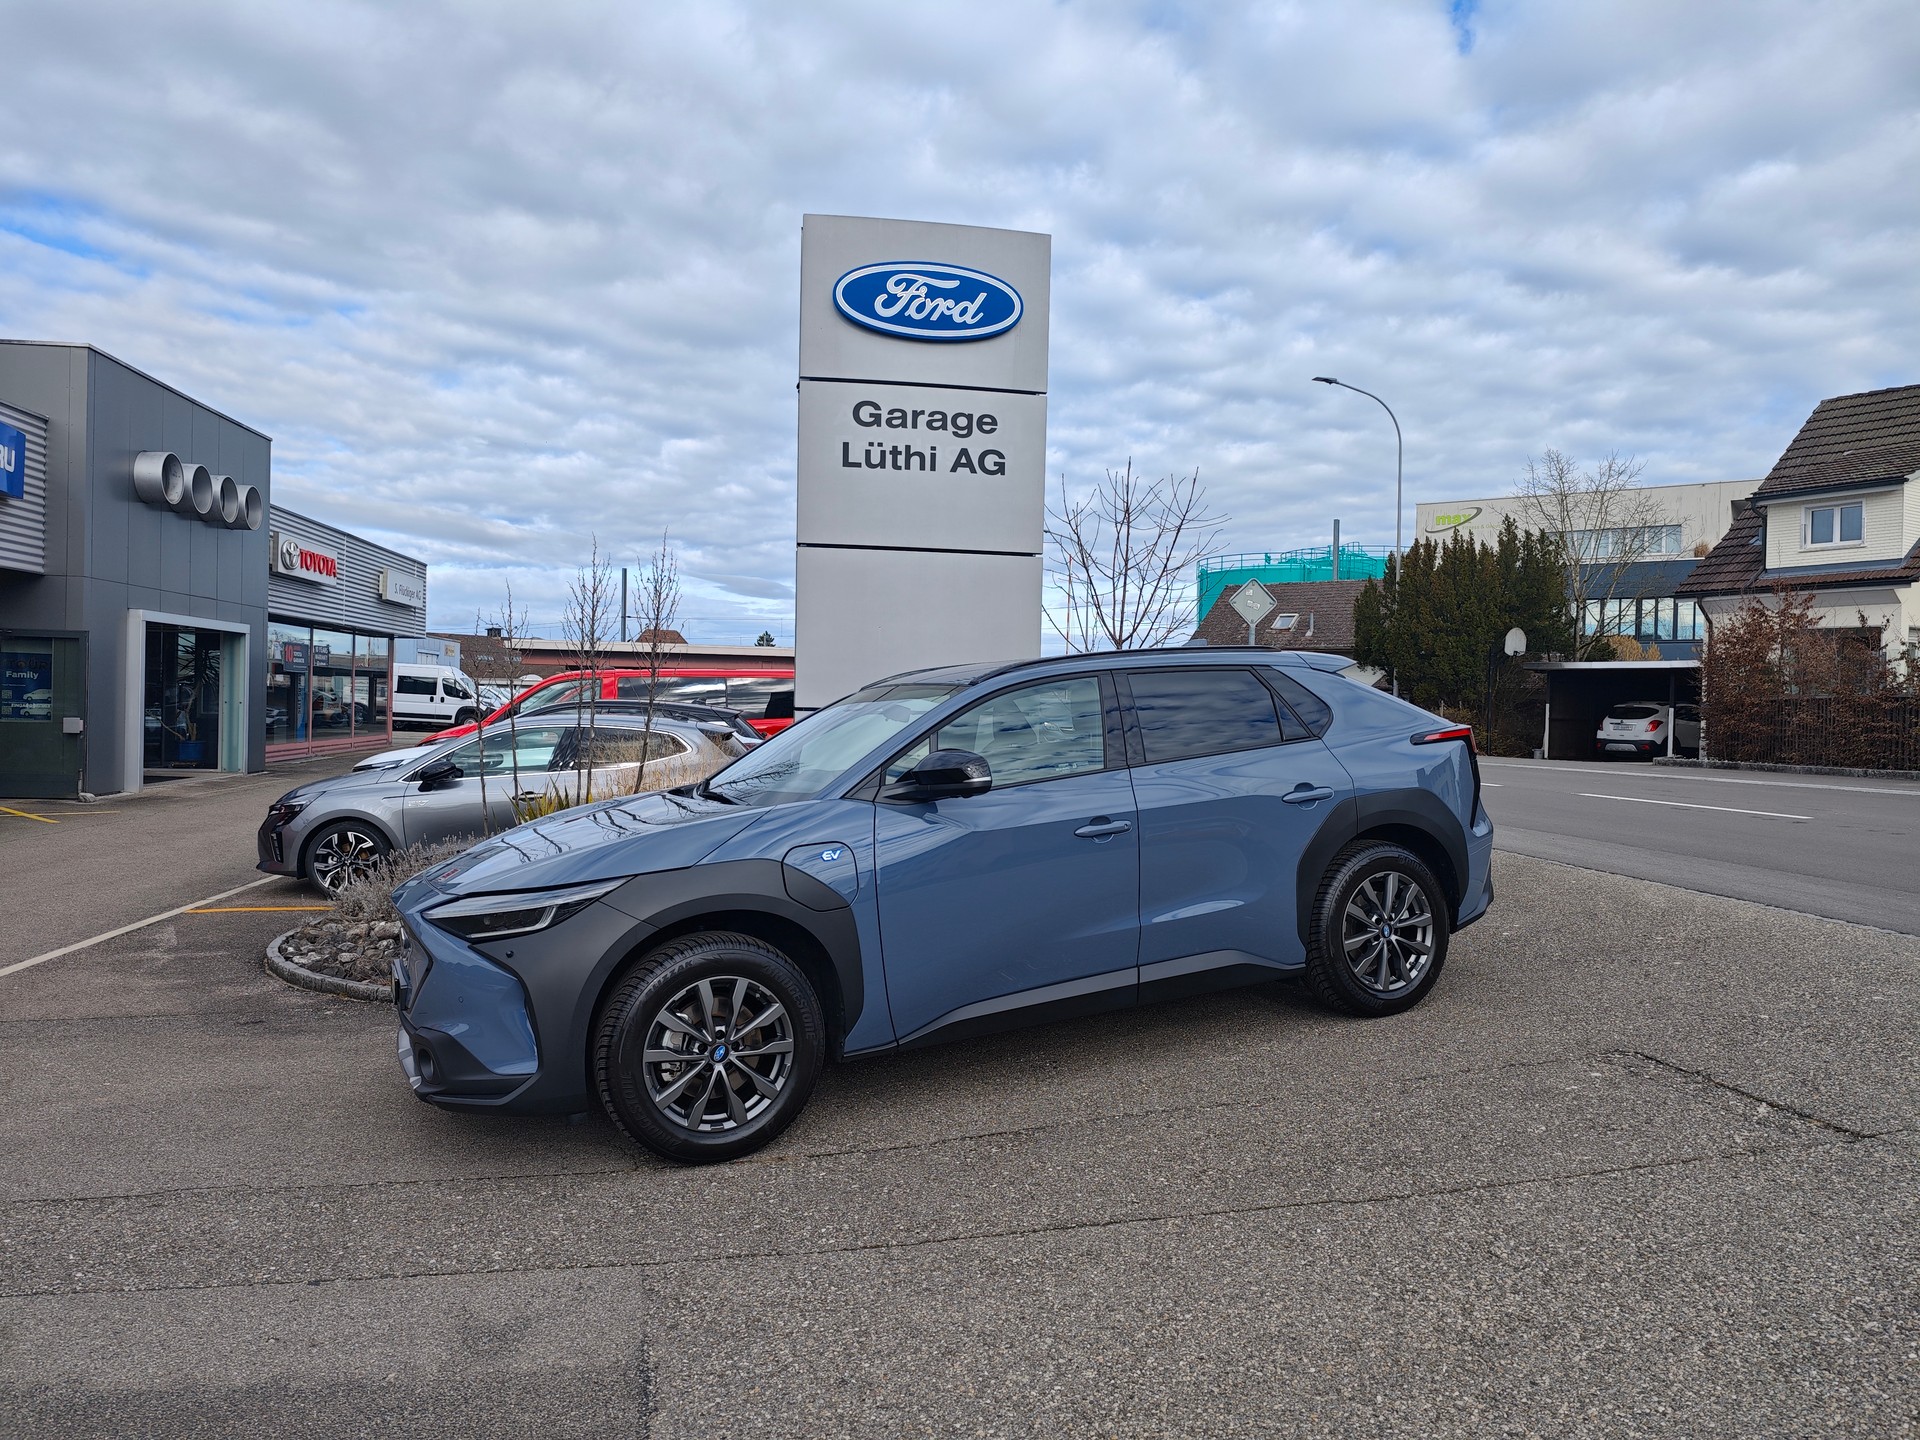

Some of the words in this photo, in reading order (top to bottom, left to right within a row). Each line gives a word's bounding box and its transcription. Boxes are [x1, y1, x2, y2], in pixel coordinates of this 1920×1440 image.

[874, 273, 988, 325] Ford
[852, 400, 998, 438] Garage
[841, 441, 937, 472] Lüthi
[949, 447, 1006, 476] AG
[299, 548, 337, 578] TOYOTA
[5, 671, 39, 680] Family
[821, 850, 841, 861] EV
